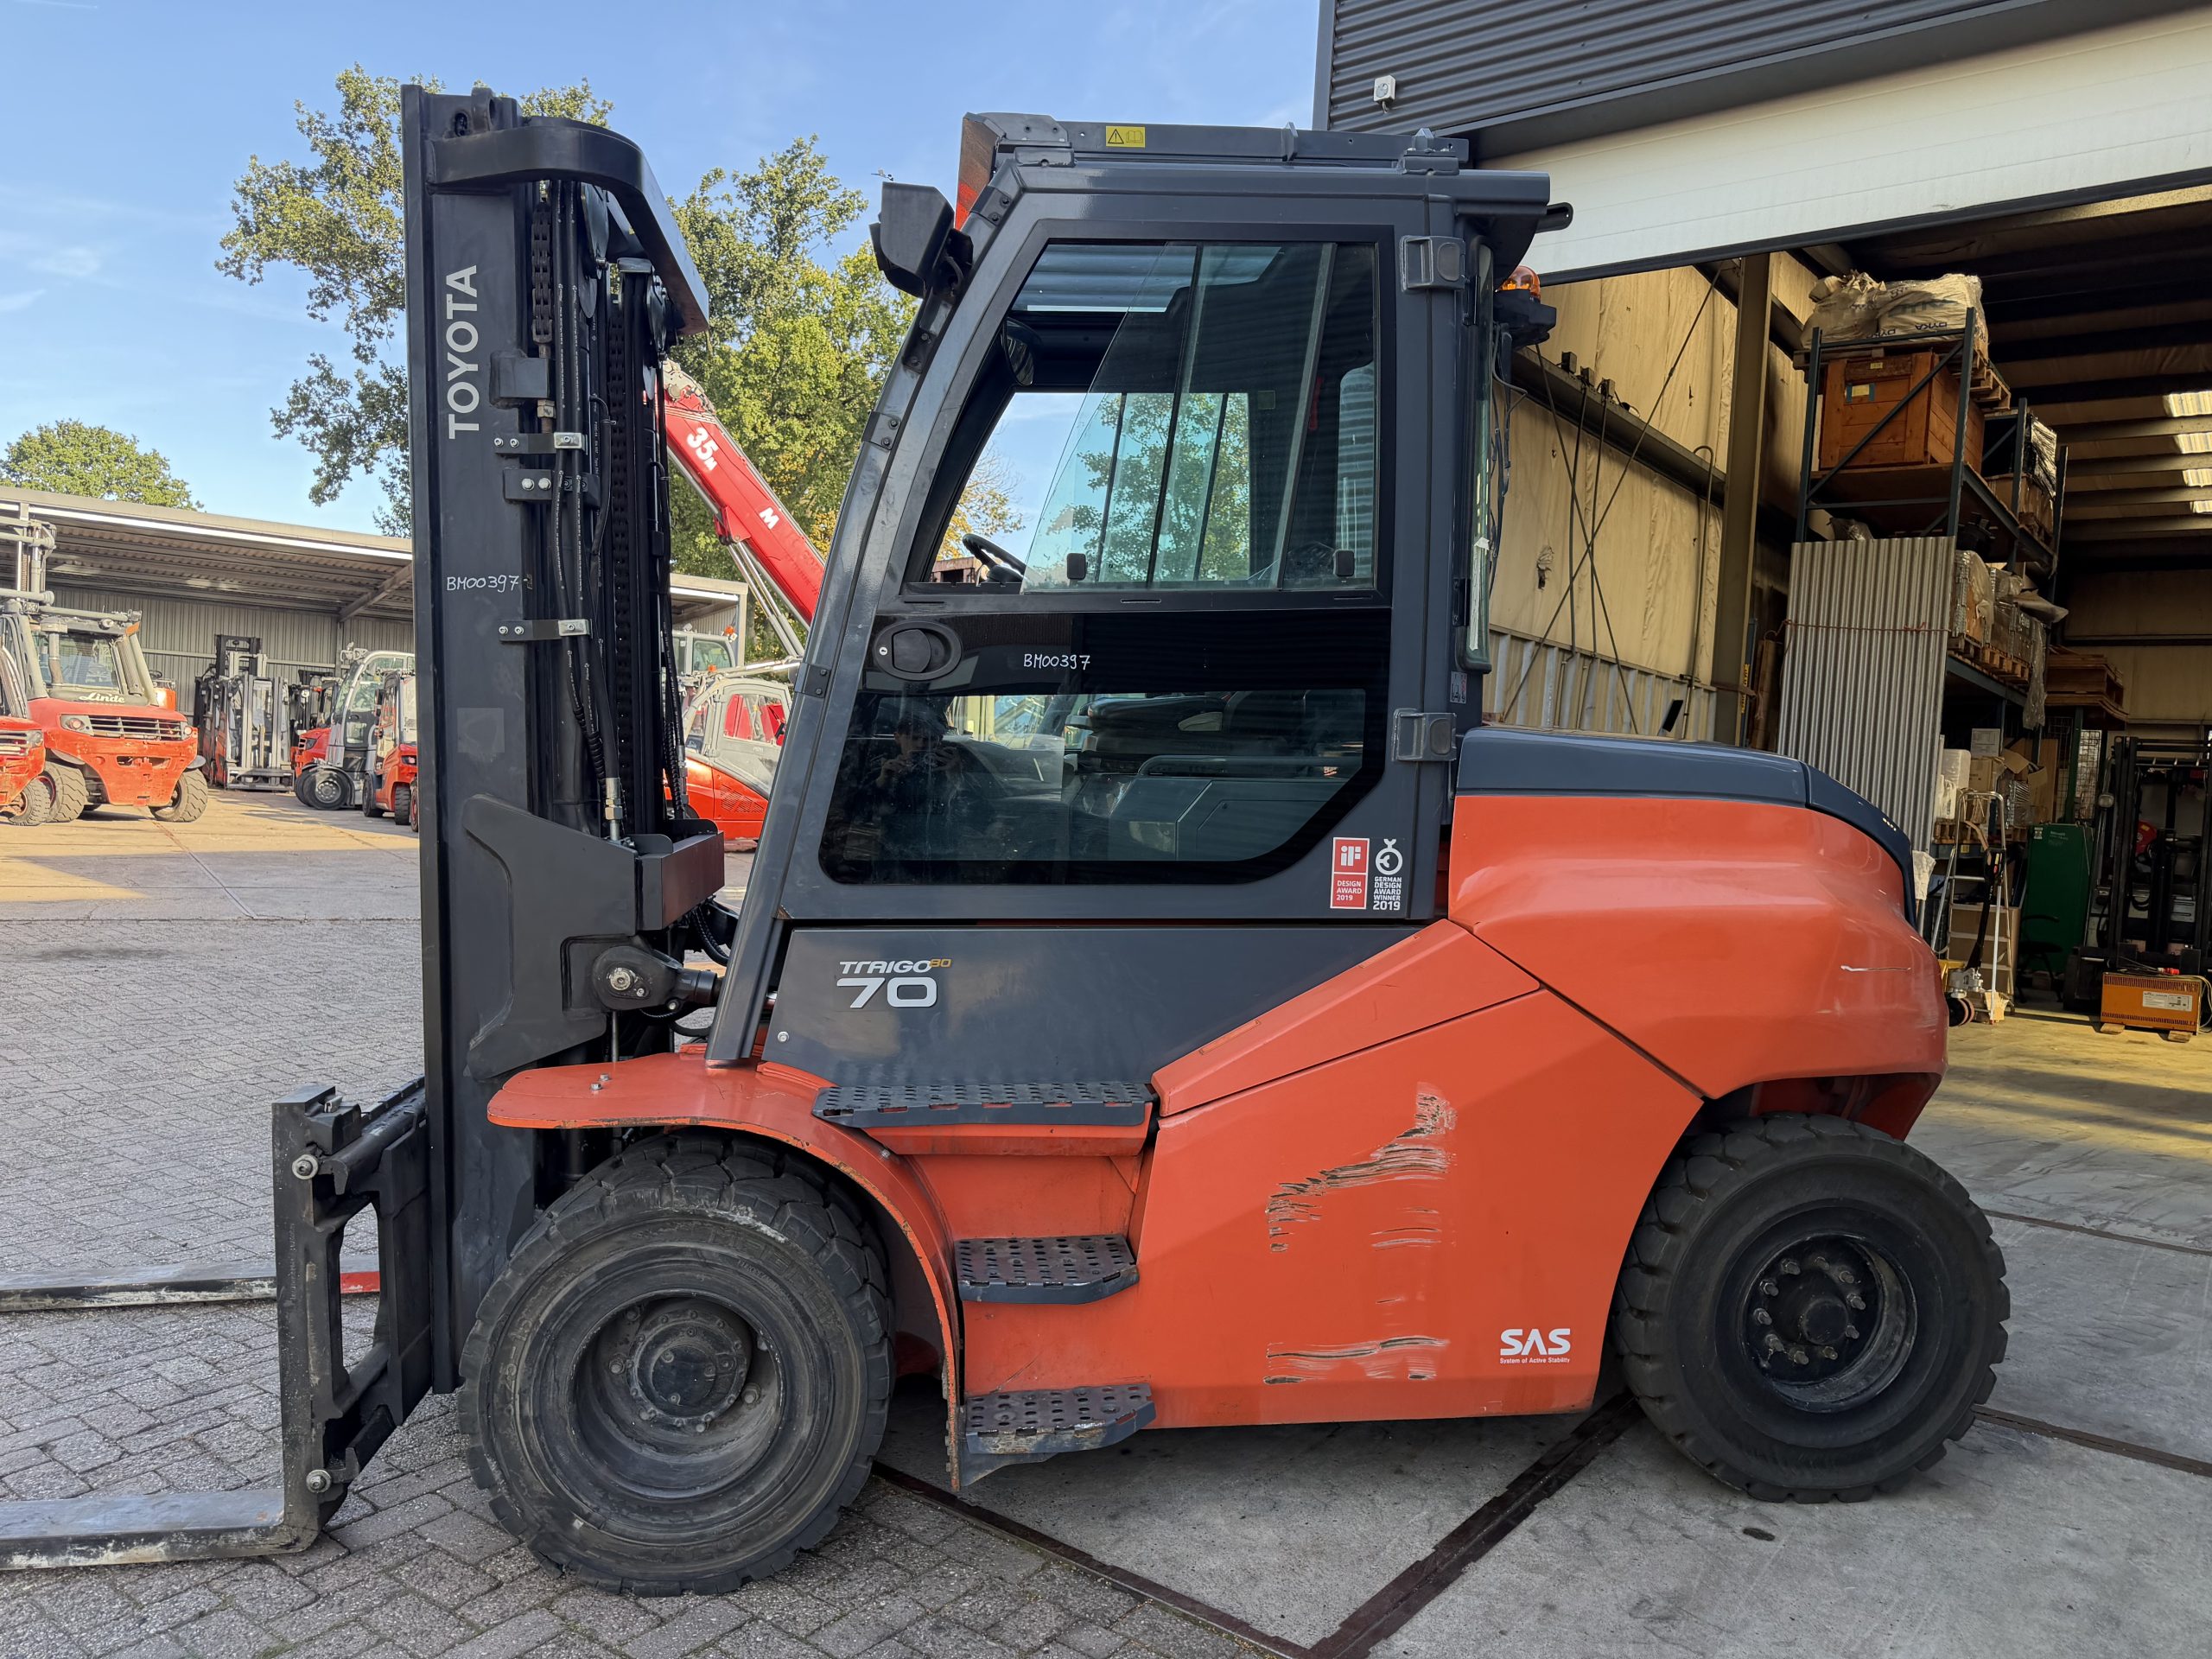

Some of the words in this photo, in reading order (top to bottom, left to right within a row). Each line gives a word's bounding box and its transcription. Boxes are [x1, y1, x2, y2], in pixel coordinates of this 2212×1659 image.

[446, 264, 480, 440] TOYOTA
[759, 506, 780, 530] M
[446, 575, 520, 592] BM00397
[1023, 653, 1090, 671] BM00397
[79, 692, 125, 703] Linde
[1372, 900, 1401, 911] 2019
[836, 976, 938, 1008] 70
[1500, 1328, 1571, 1356] SAS
